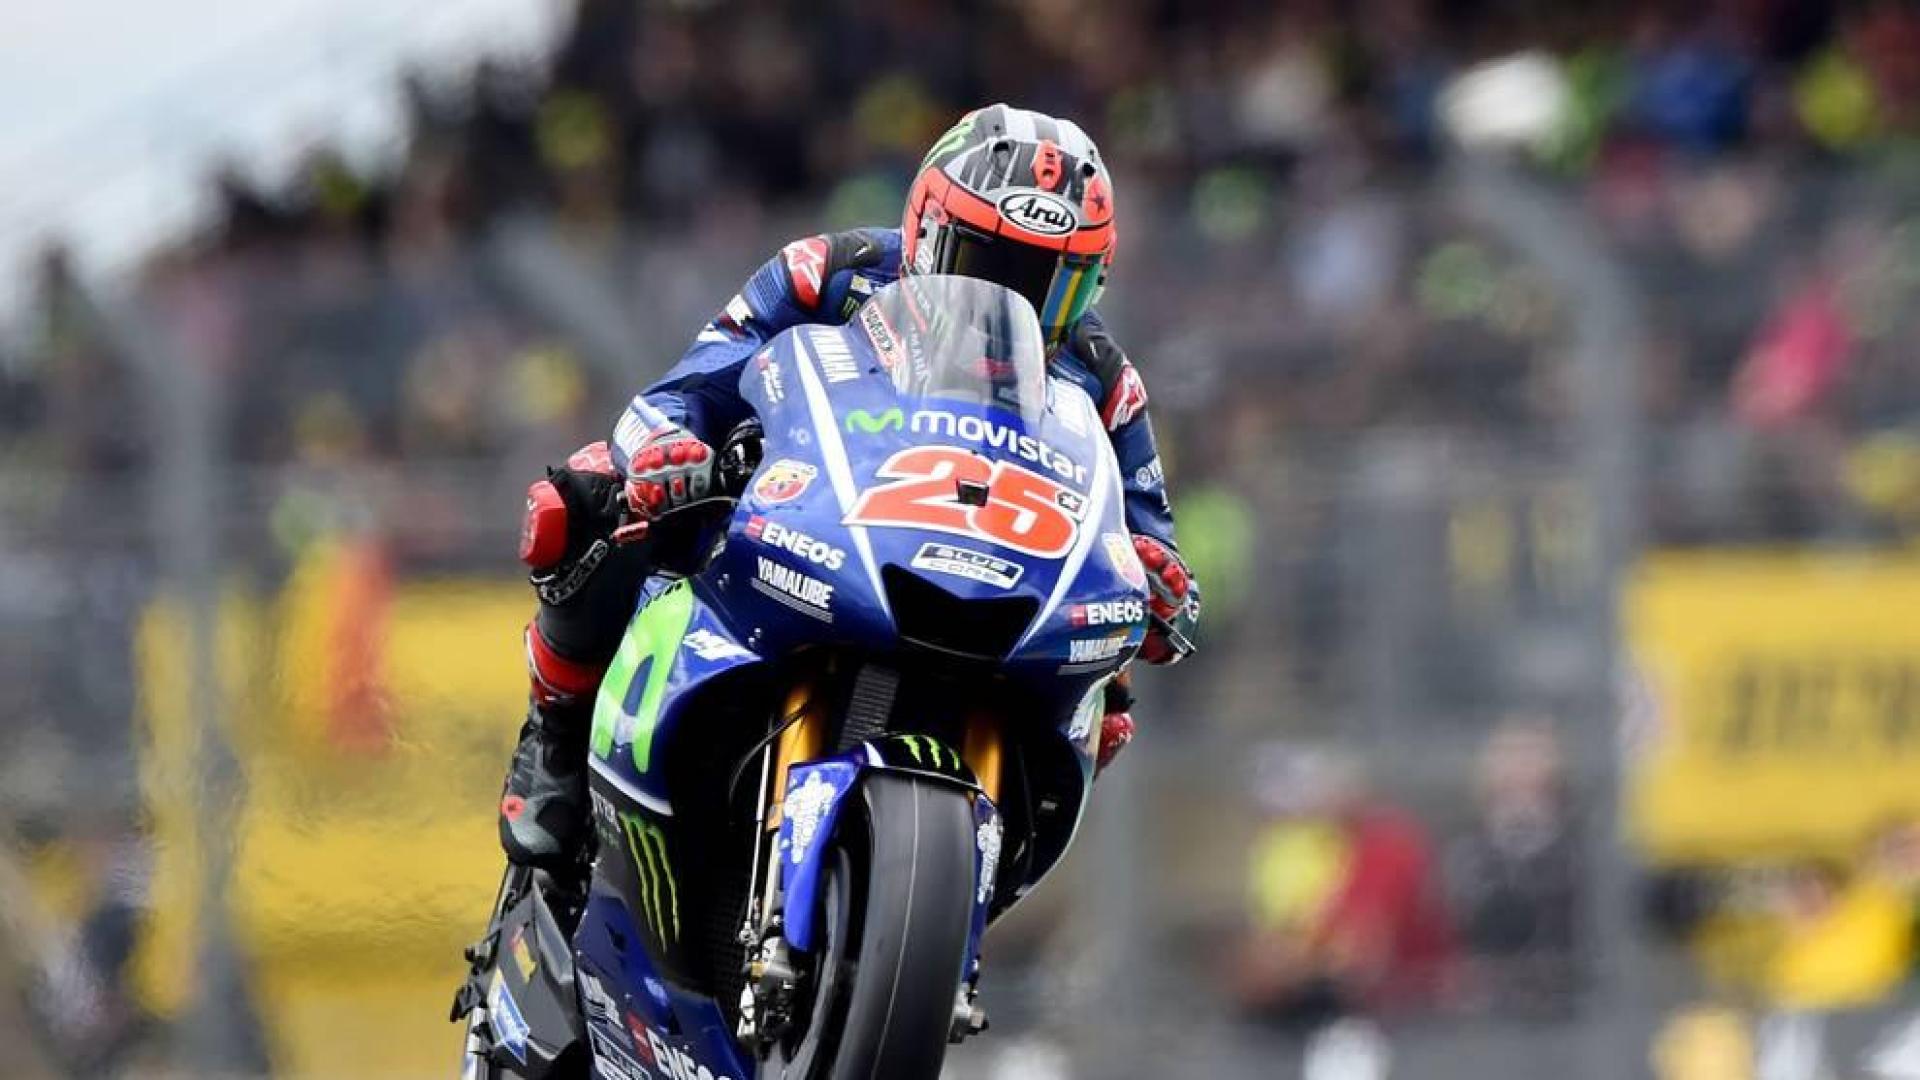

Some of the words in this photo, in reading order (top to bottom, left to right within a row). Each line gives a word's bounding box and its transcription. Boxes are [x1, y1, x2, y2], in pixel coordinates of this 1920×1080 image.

[1005, 197, 1067, 228] Arai
[808, 328, 860, 383] YAMAHA
[911, 410, 1087, 485] movistar
[841, 446, 1078, 559] 25
[761, 521, 847, 570] ENEOS
[757, 556, 835, 609] YAMALUBE
[1087, 600, 1144, 625] ENEOS
